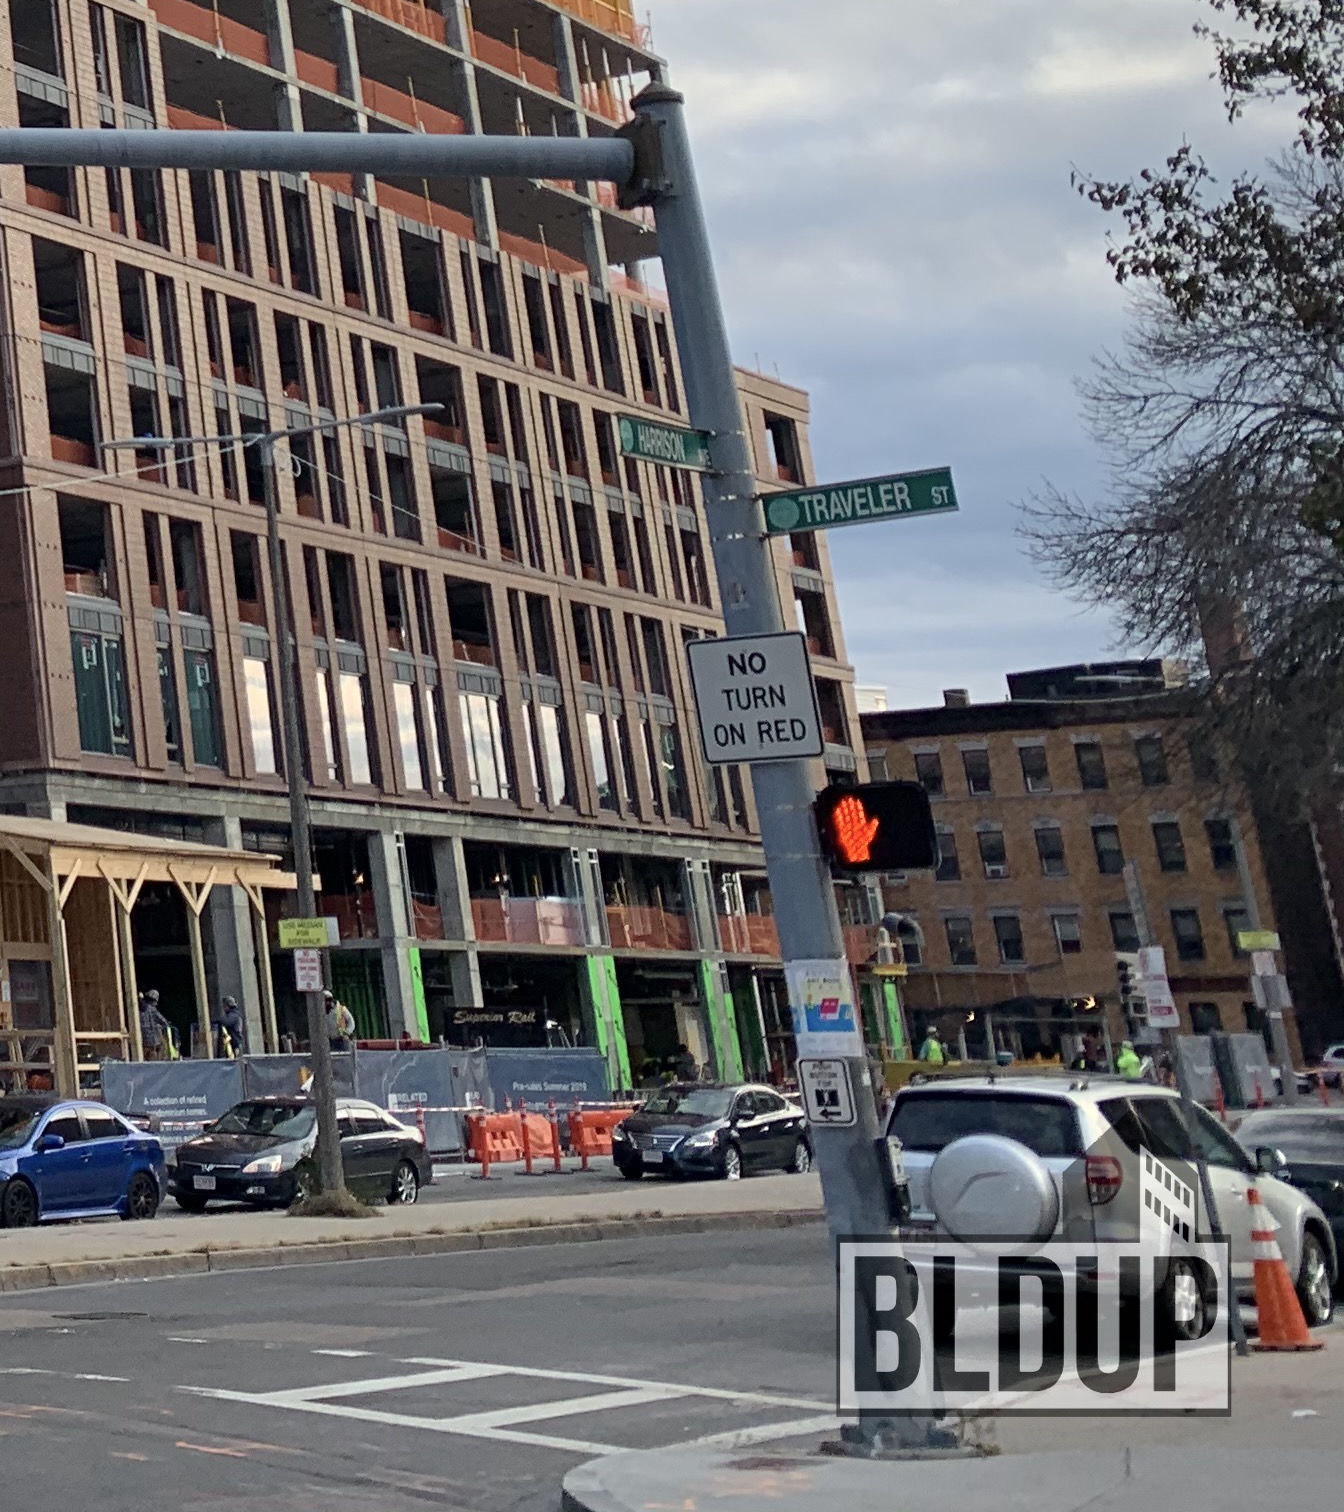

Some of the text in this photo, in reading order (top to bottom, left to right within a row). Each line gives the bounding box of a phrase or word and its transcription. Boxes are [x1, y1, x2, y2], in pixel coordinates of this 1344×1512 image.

[637, 424, 686, 462] HARRISON
[798, 481, 949, 523] TRAVELER ST
[727, 652, 766, 676] NO
[721, 684, 786, 711] TURN
[713, 718, 806, 747] ON RED
